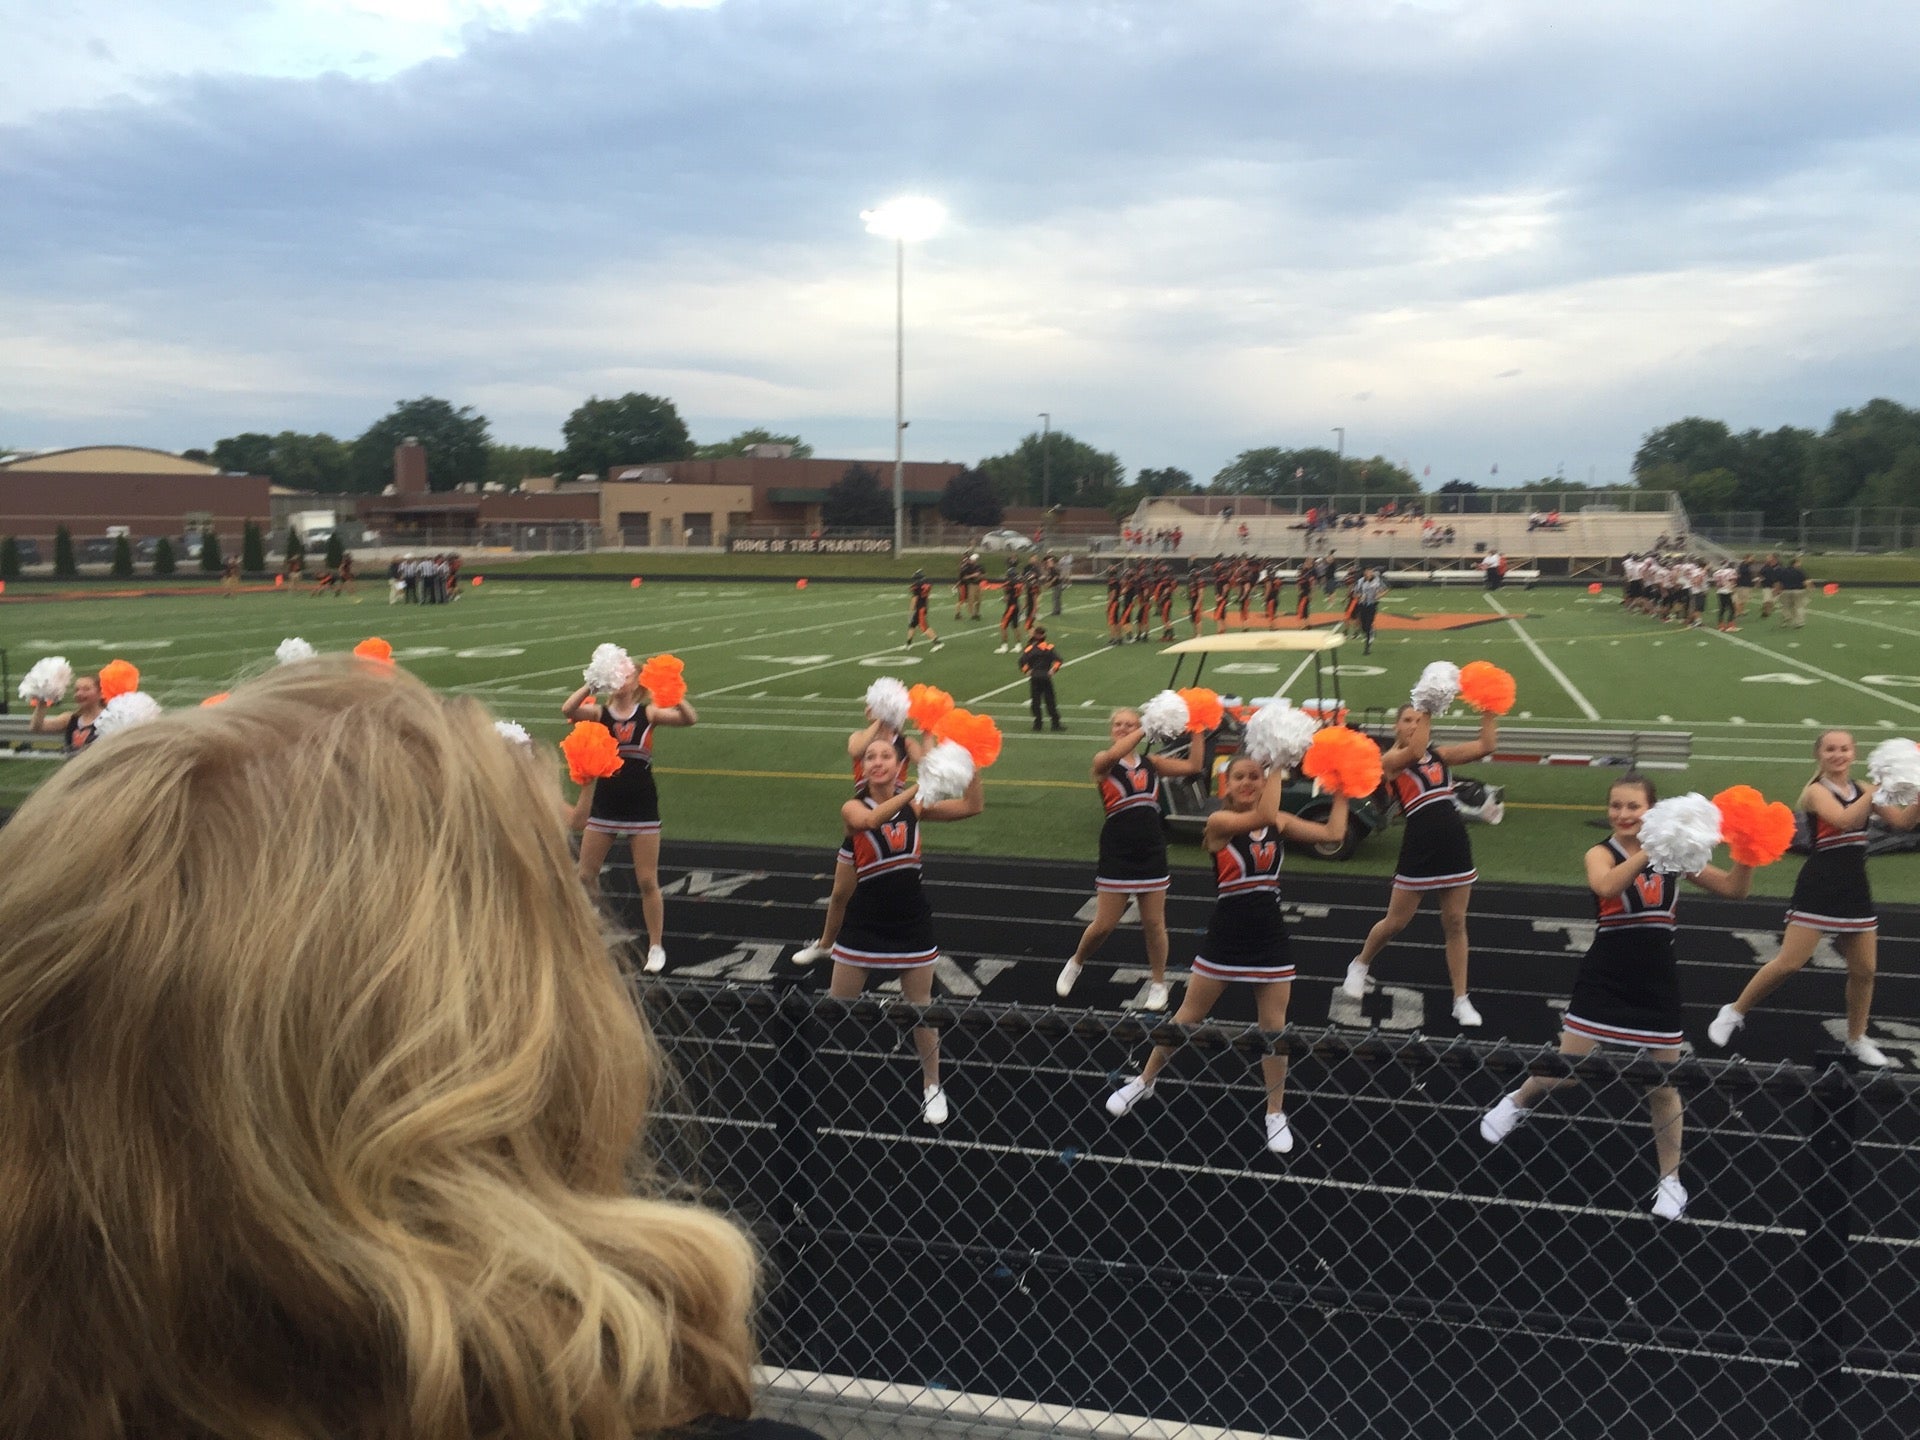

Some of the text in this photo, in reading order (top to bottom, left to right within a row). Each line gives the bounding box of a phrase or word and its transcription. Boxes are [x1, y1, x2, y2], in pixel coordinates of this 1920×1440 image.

[732, 539, 892, 552] HOME OF THE PHANTOMS
[613, 721, 637, 744] W
[881, 820, 908, 854] W
[1249, 840, 1278, 873] W
[1633, 872, 1665, 908] W
